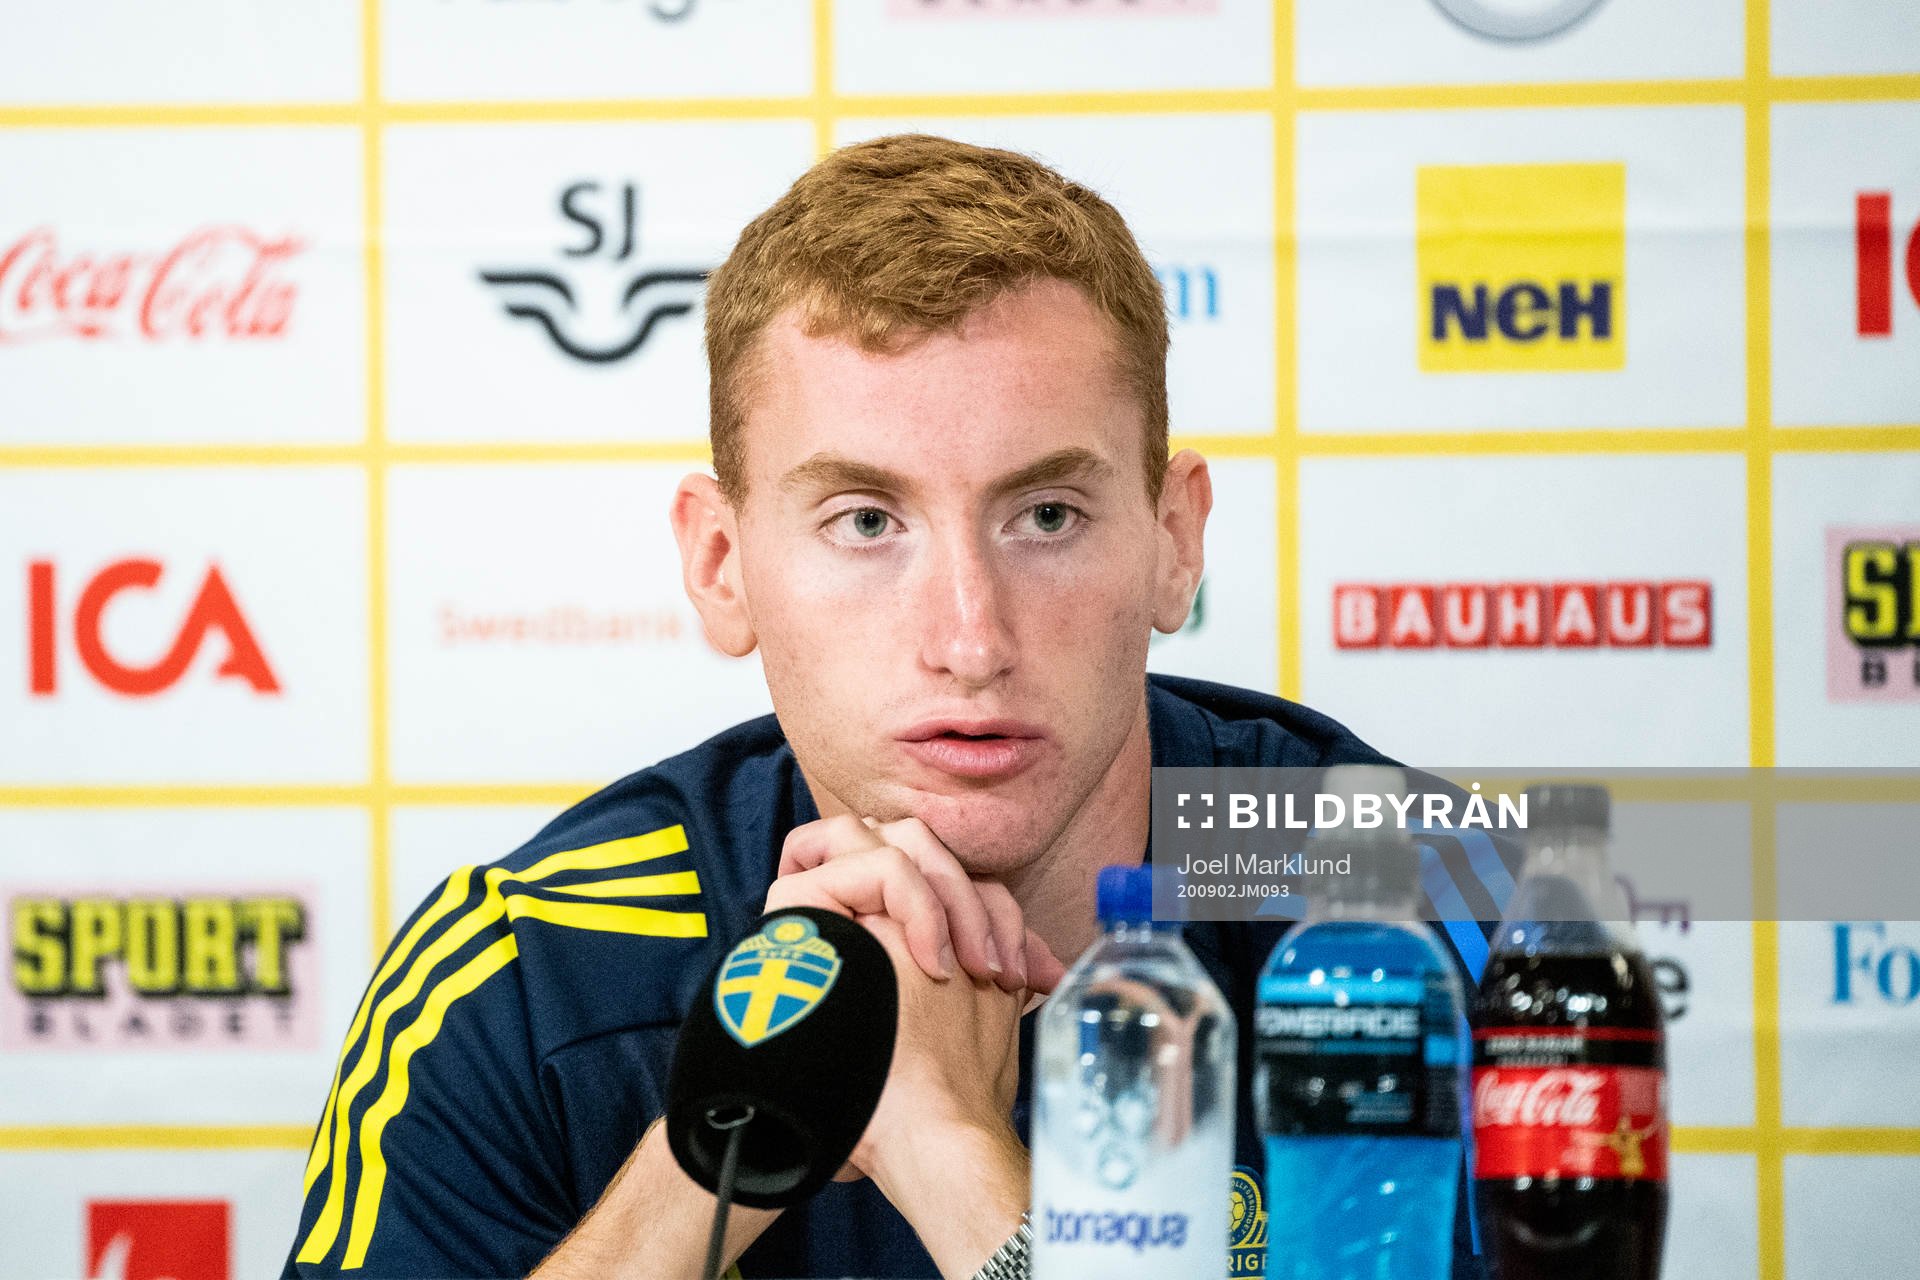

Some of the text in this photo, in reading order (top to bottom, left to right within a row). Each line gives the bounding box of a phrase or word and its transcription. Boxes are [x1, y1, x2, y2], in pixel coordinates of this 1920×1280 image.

[558, 179, 640, 261] SJ
[26, 557, 284, 697] ICA
[437, 601, 682, 646] Swedbank
[1334, 584, 1710, 647] BAUHAUS
[13, 895, 308, 998] SPORT
[27, 1003, 294, 1040] BLADET
